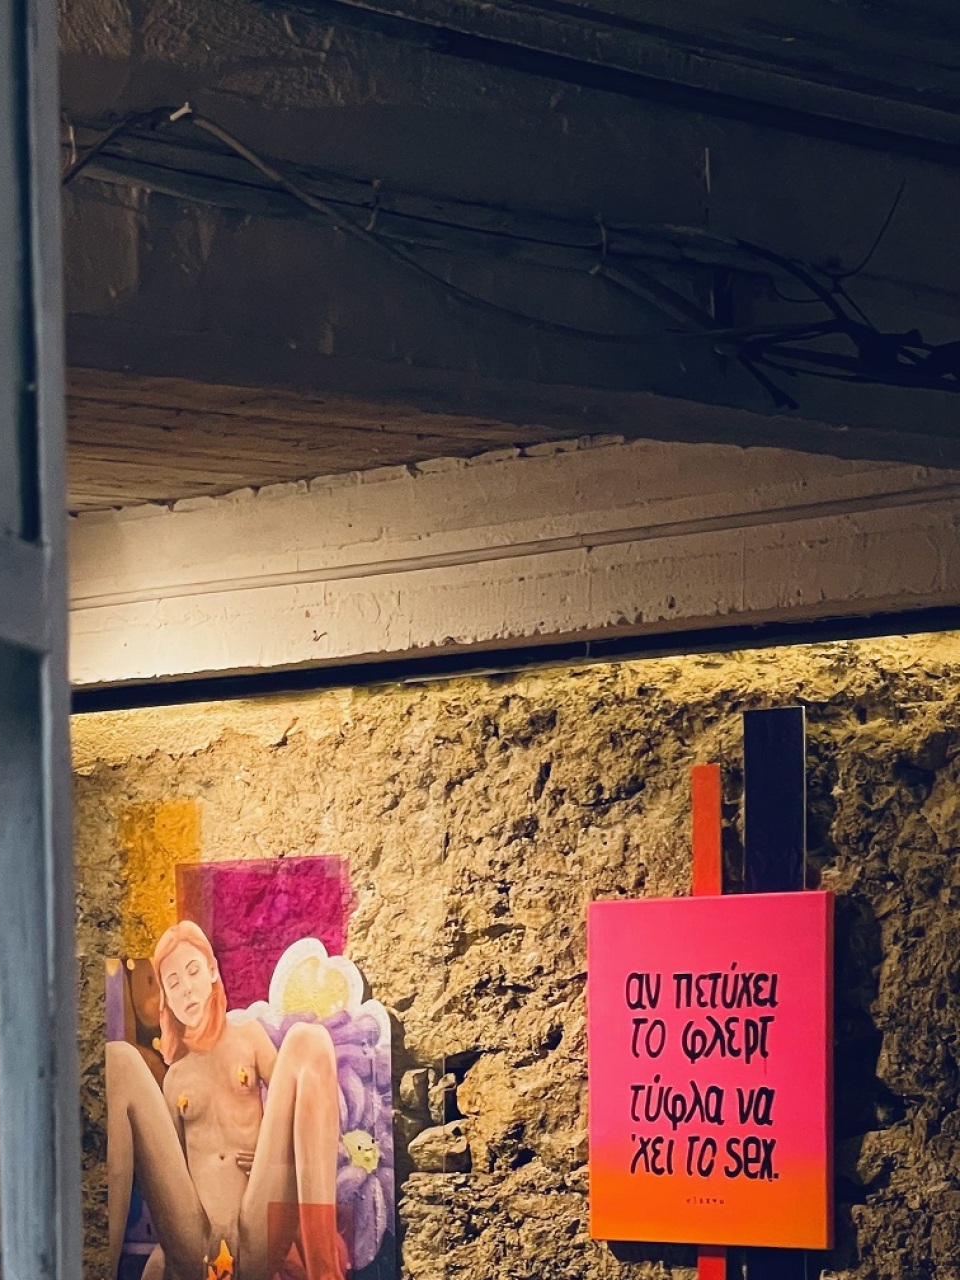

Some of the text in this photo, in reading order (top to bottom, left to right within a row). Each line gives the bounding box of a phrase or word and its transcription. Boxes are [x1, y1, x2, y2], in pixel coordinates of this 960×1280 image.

[626, 963, 778, 1009] αν πετύχει
[632, 1016, 774, 1064] το φλερτ
[631, 1075, 775, 1127] τύφλα να
[687, 1136, 717, 1177] το
[724, 1136, 778, 1181] sex.
